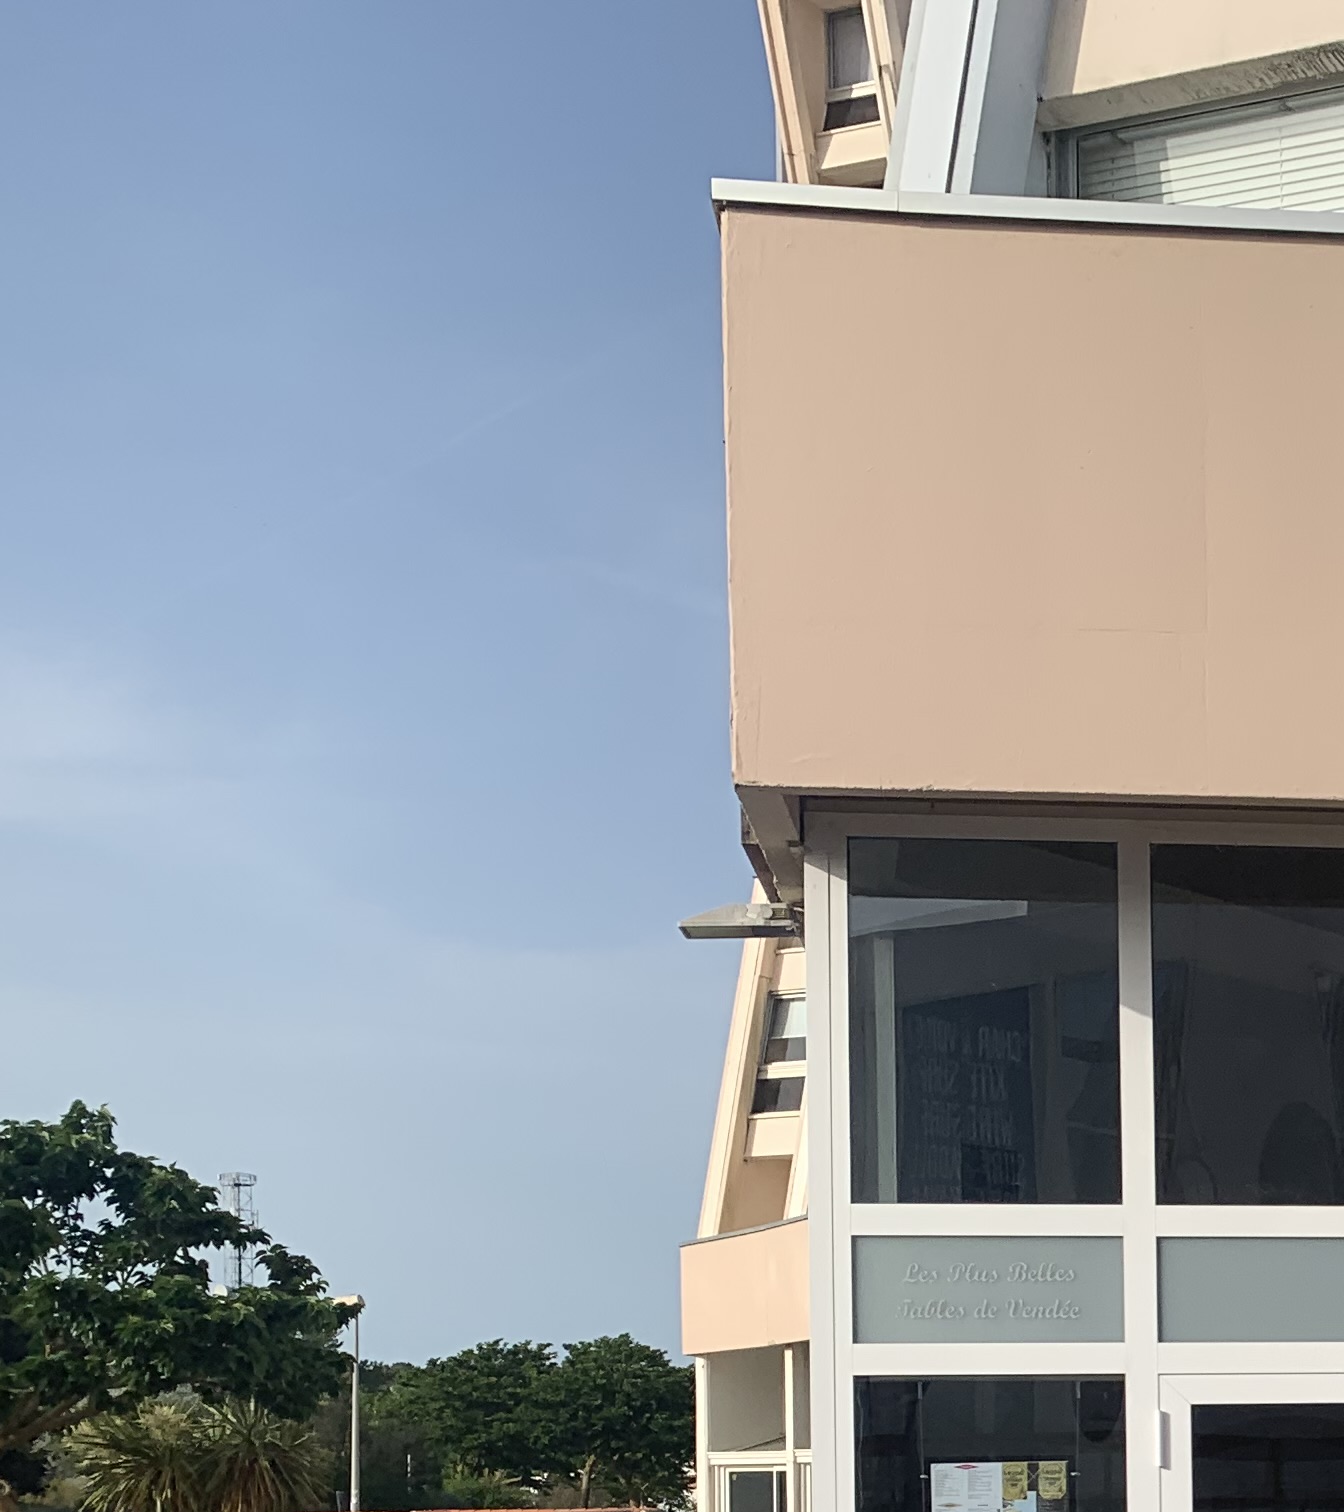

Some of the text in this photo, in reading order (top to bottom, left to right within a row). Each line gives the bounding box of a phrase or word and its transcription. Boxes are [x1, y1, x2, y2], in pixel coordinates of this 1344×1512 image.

[902, 1261, 1075, 1283] Les Plus Belles
[897, 1299, 1081, 1320] Tables de Vendée
